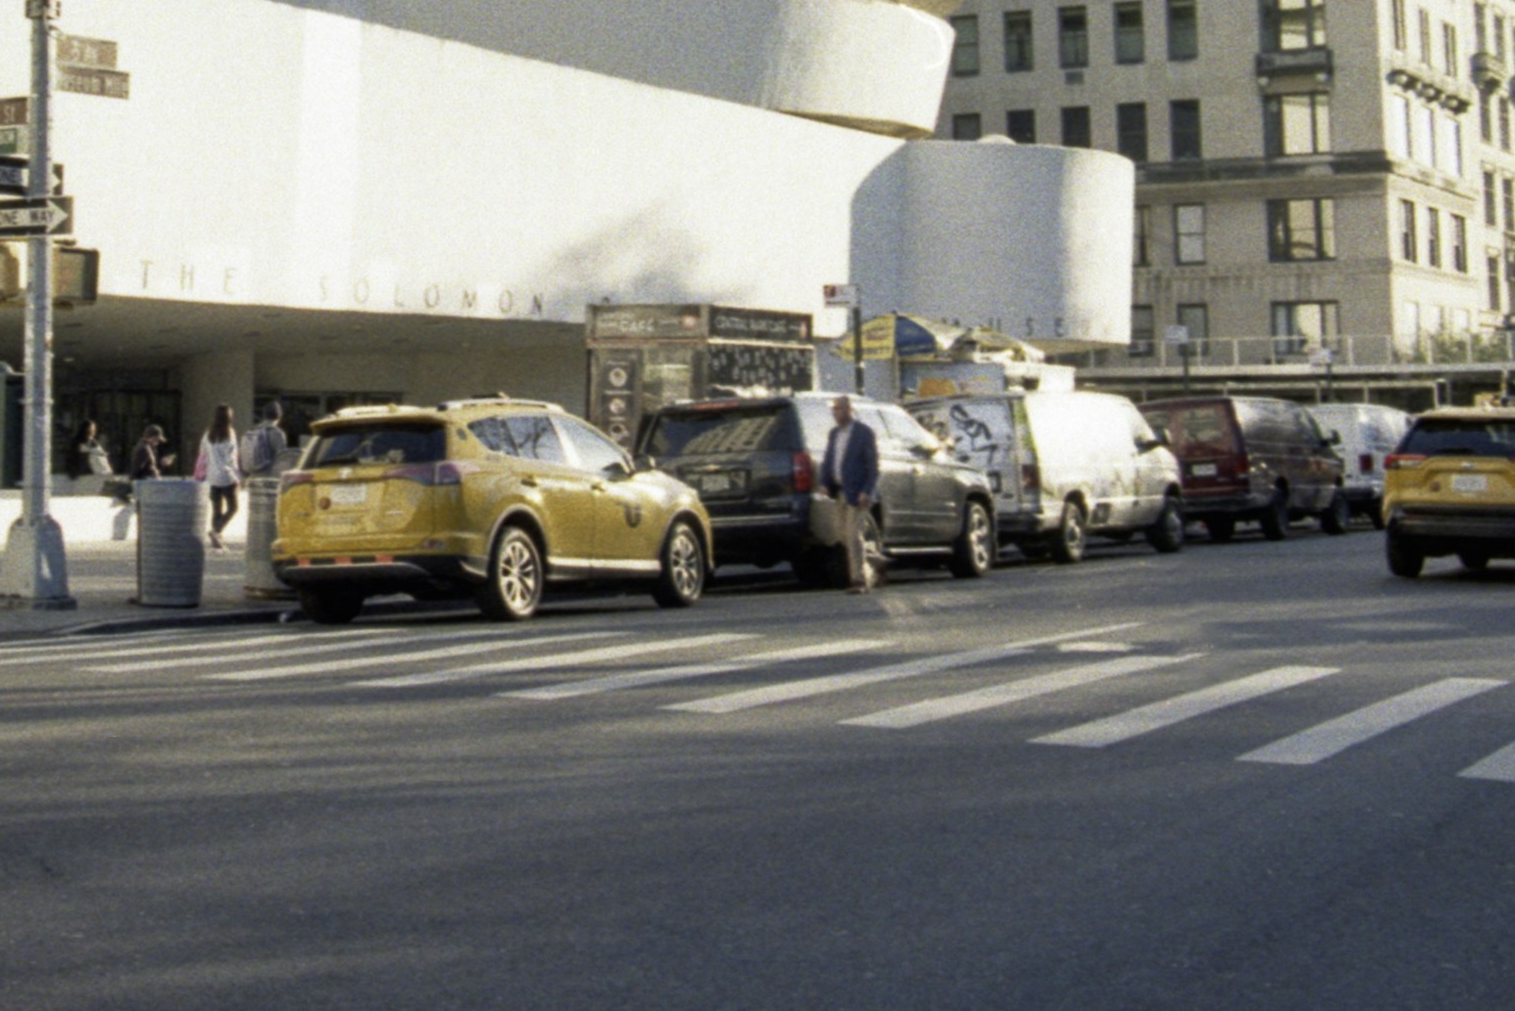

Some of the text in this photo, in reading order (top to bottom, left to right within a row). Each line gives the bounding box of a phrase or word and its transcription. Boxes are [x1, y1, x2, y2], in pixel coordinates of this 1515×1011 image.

[30, 208, 54, 224] WAY
[139, 259, 544, 316] THE SOLOMON
